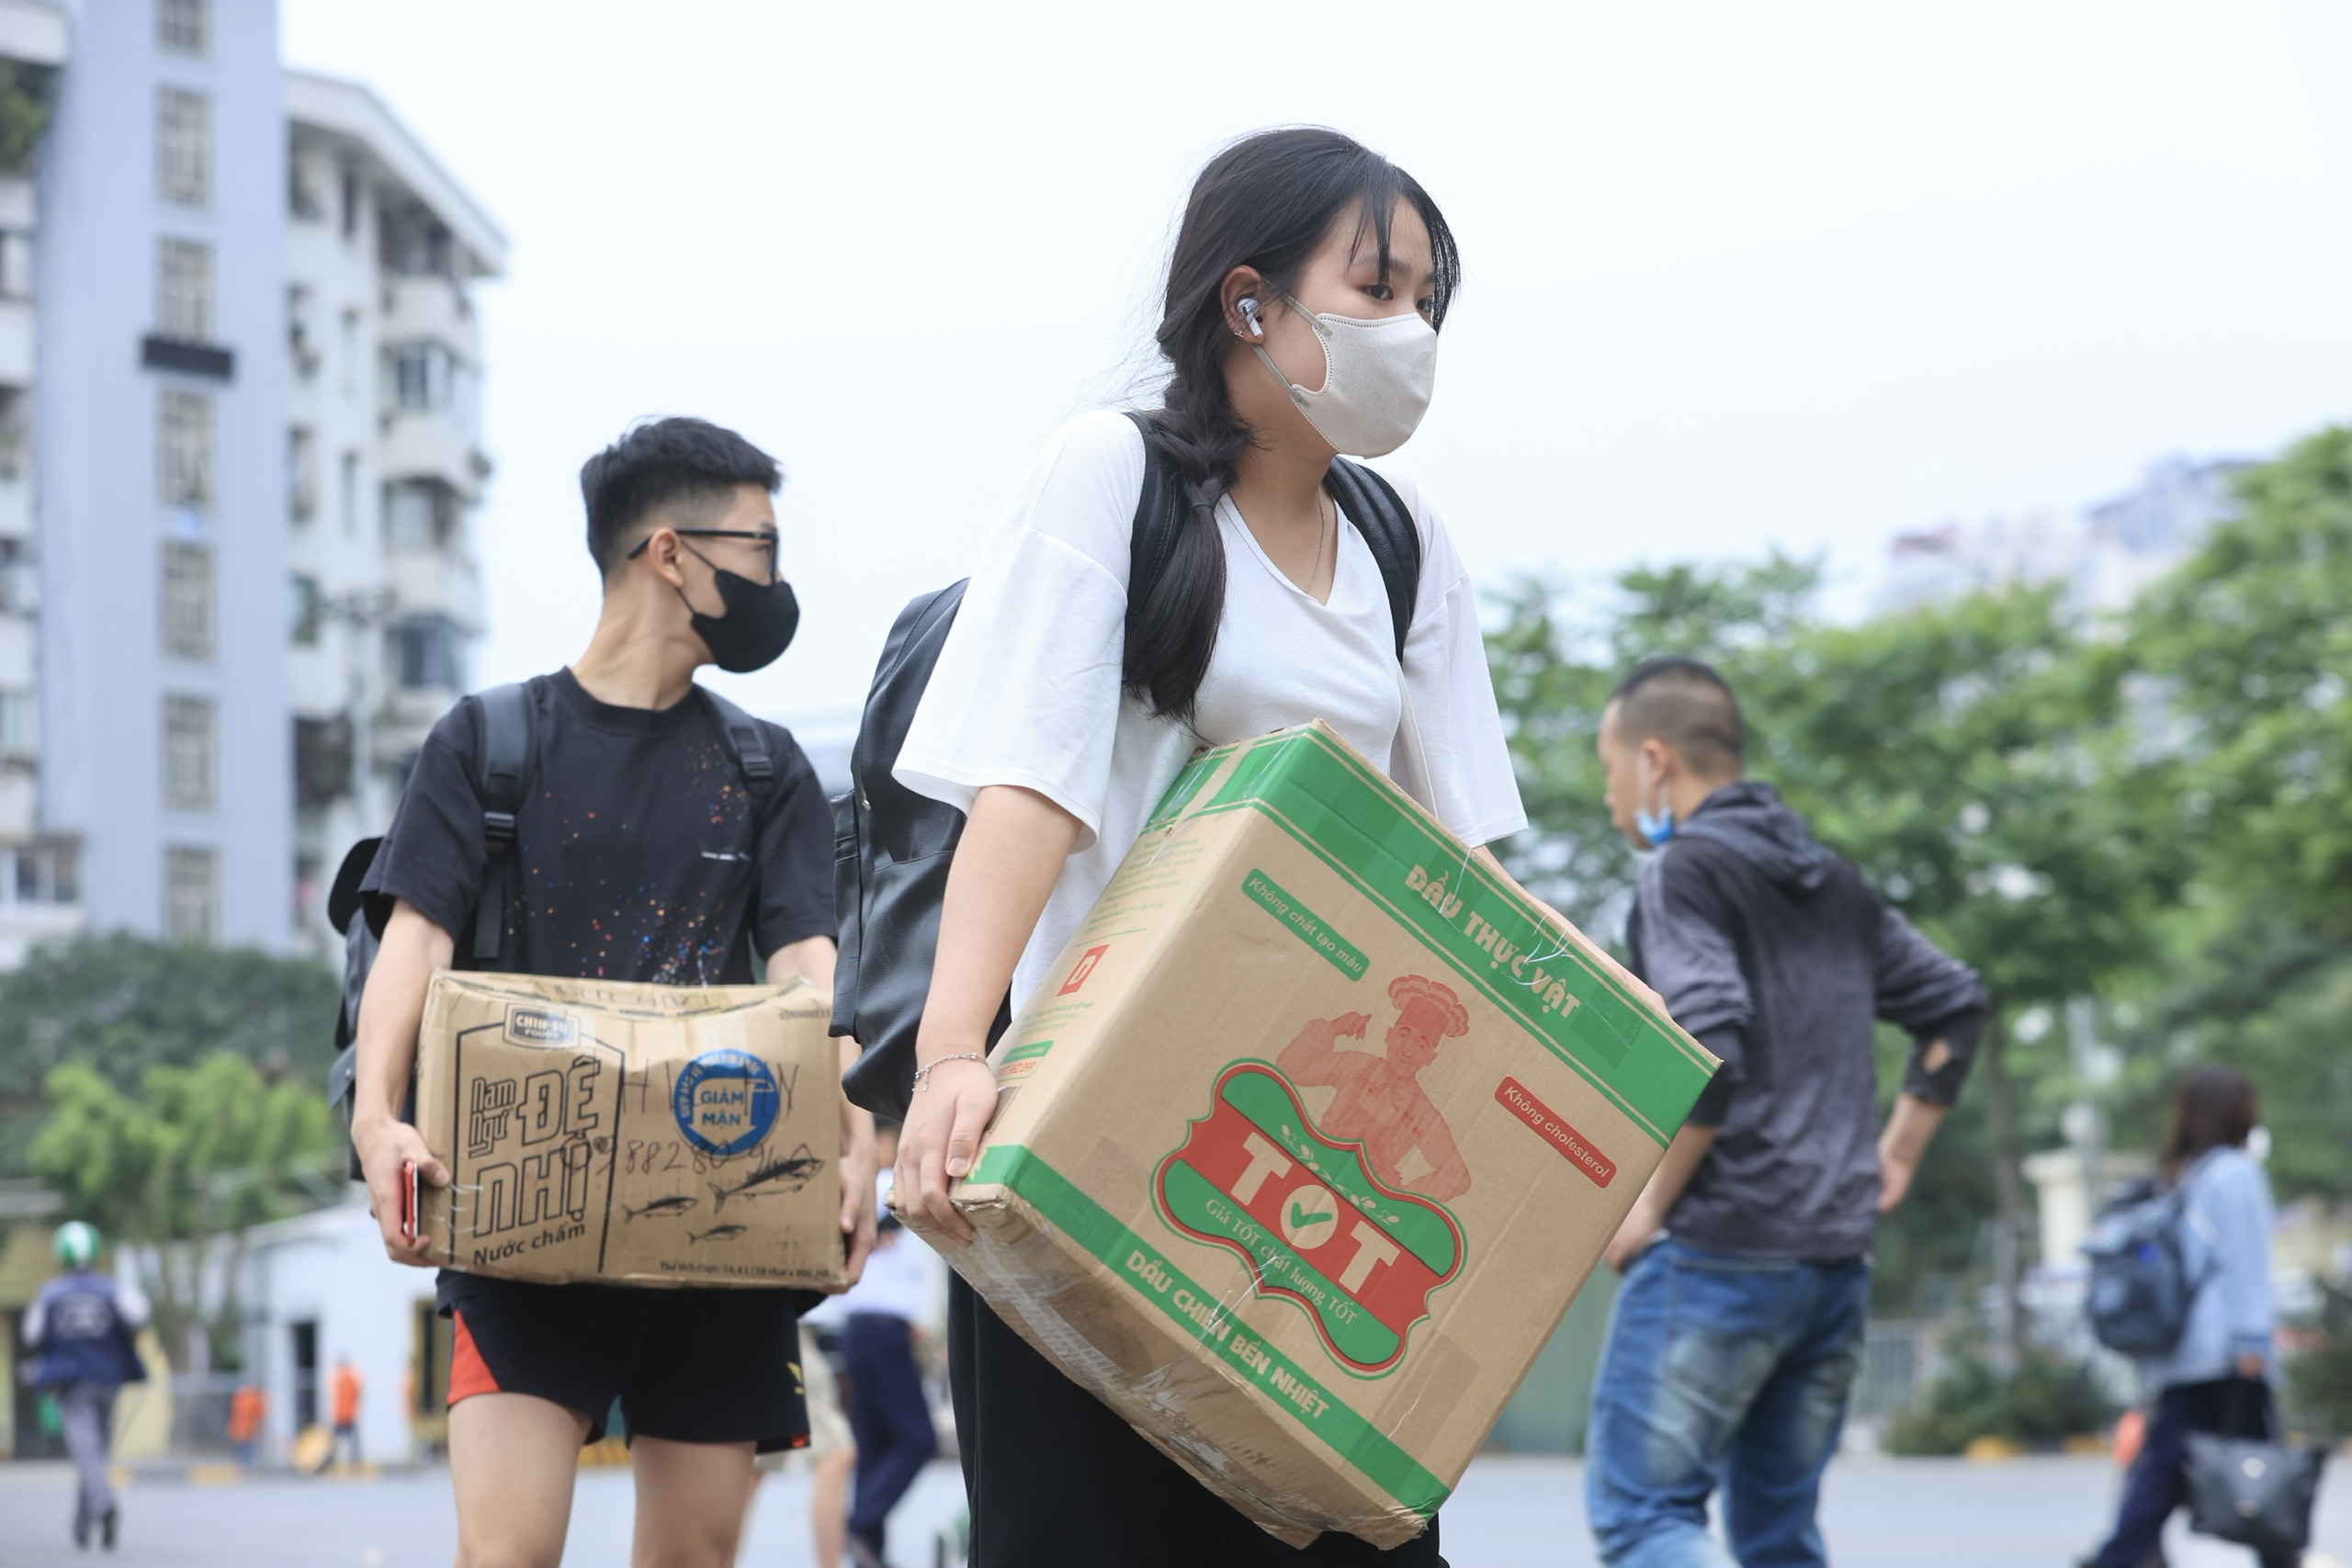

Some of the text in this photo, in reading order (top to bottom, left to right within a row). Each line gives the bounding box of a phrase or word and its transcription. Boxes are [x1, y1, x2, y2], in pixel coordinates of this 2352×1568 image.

[1249, 878, 1363, 973] Không chất tạo màu
[1405, 863, 1581, 1019] DẦU THỰC VẬT
[700, 1086, 745, 1105] GIẢM
[1504, 1087, 1611, 1178] Không cholesterol
[473, 1222, 585, 1266] Nước chấm
[1205, 1199, 1231, 1224] Giá
[1232, 1221, 1261, 1247] TỐT
[1290, 1268, 1326, 1306] lượng
[1328, 1296, 1358, 1325] TỐT
[1125, 1249, 1173, 1293] DẦU
[1228, 1334, 1272, 1375] BỀN
[1269, 1366, 1330, 1418] NHIỆT
